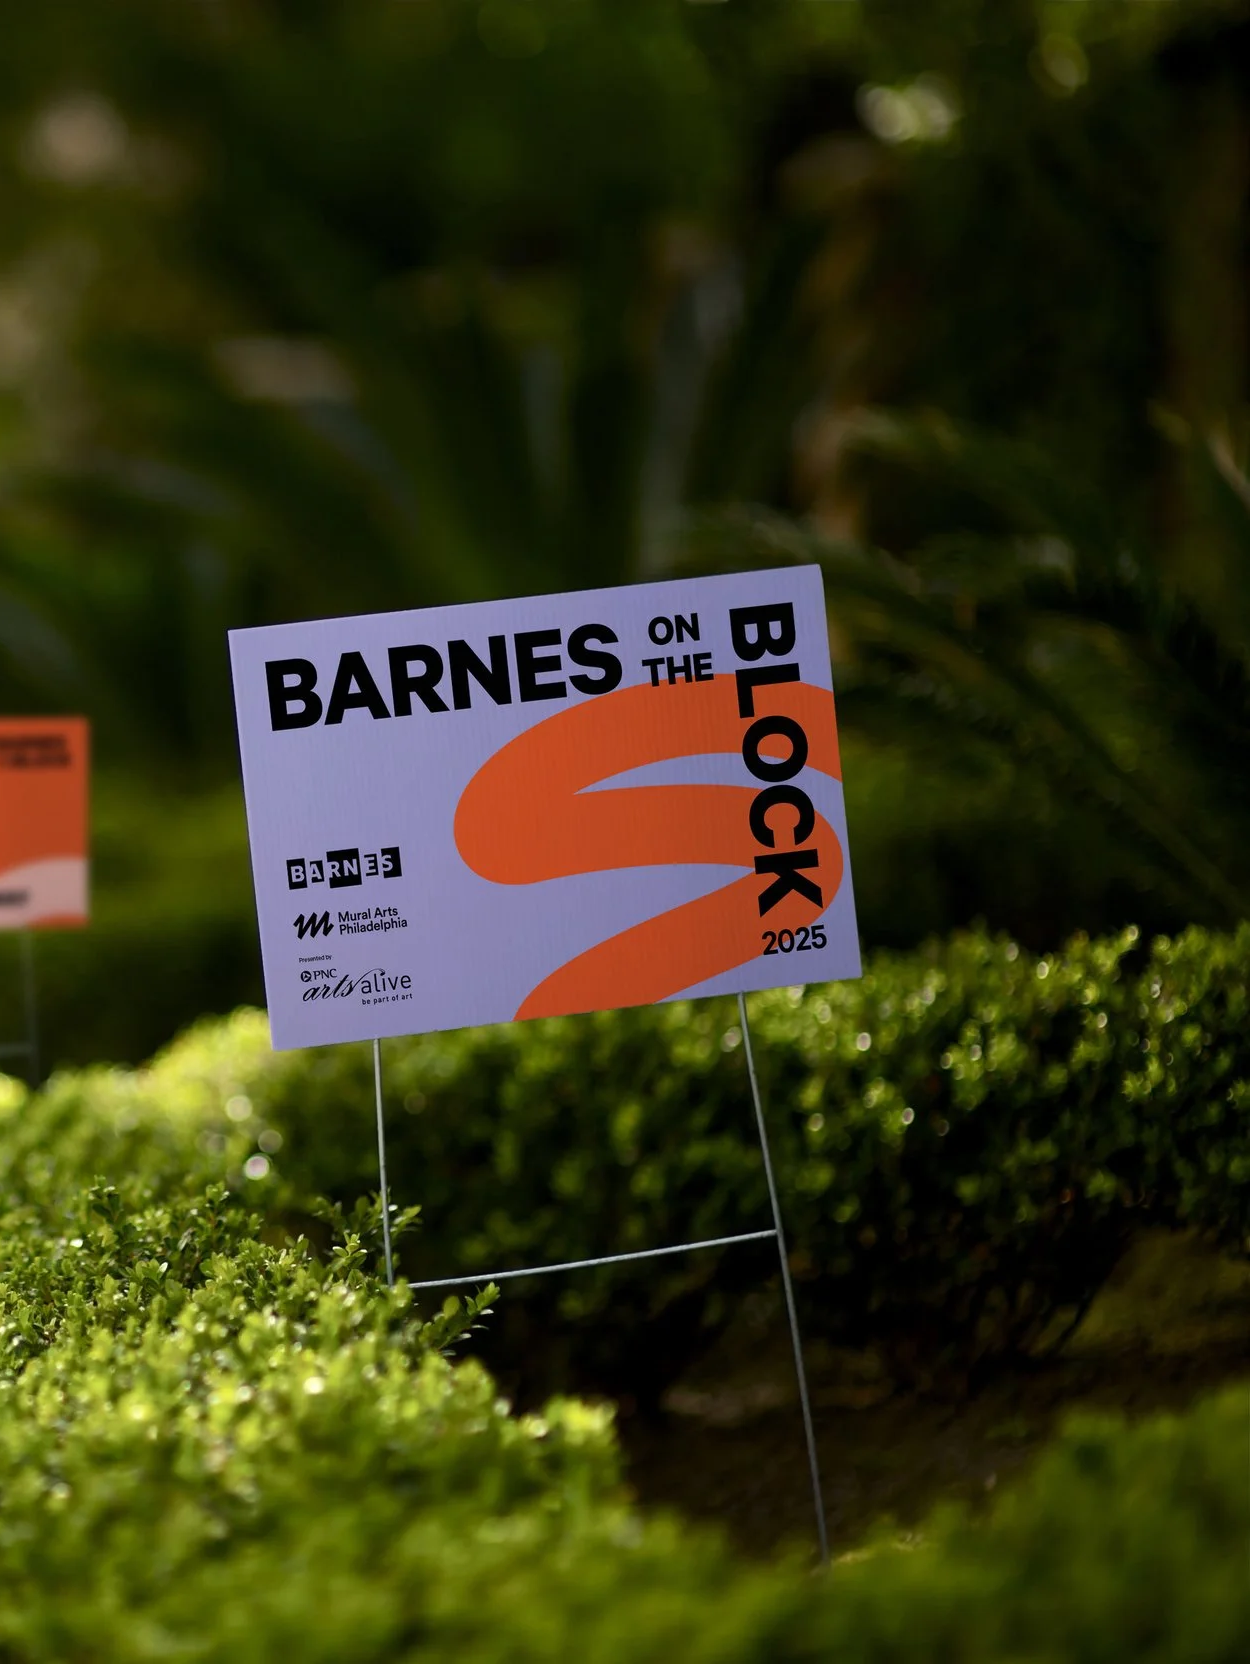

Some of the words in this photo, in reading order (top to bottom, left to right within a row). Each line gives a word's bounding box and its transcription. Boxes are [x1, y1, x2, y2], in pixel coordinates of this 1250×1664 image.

[648, 613, 701, 645] ON
[265, 623, 623, 731] BARNES
[642, 652, 715, 687] THE
[729, 602, 824, 917] BLOCK
[287, 849, 401, 888] BARNES
[338, 908, 371, 922] Mural
[374, 906, 398, 918] Arts
[339, 917, 408, 935] Philadelphia
[762, 925, 827, 956] 2025
[298, 955, 325, 963] Presented
[313, 968, 337, 980] PNC
[361, 973, 411, 994] alive
[373, 996, 389, 1005] part
